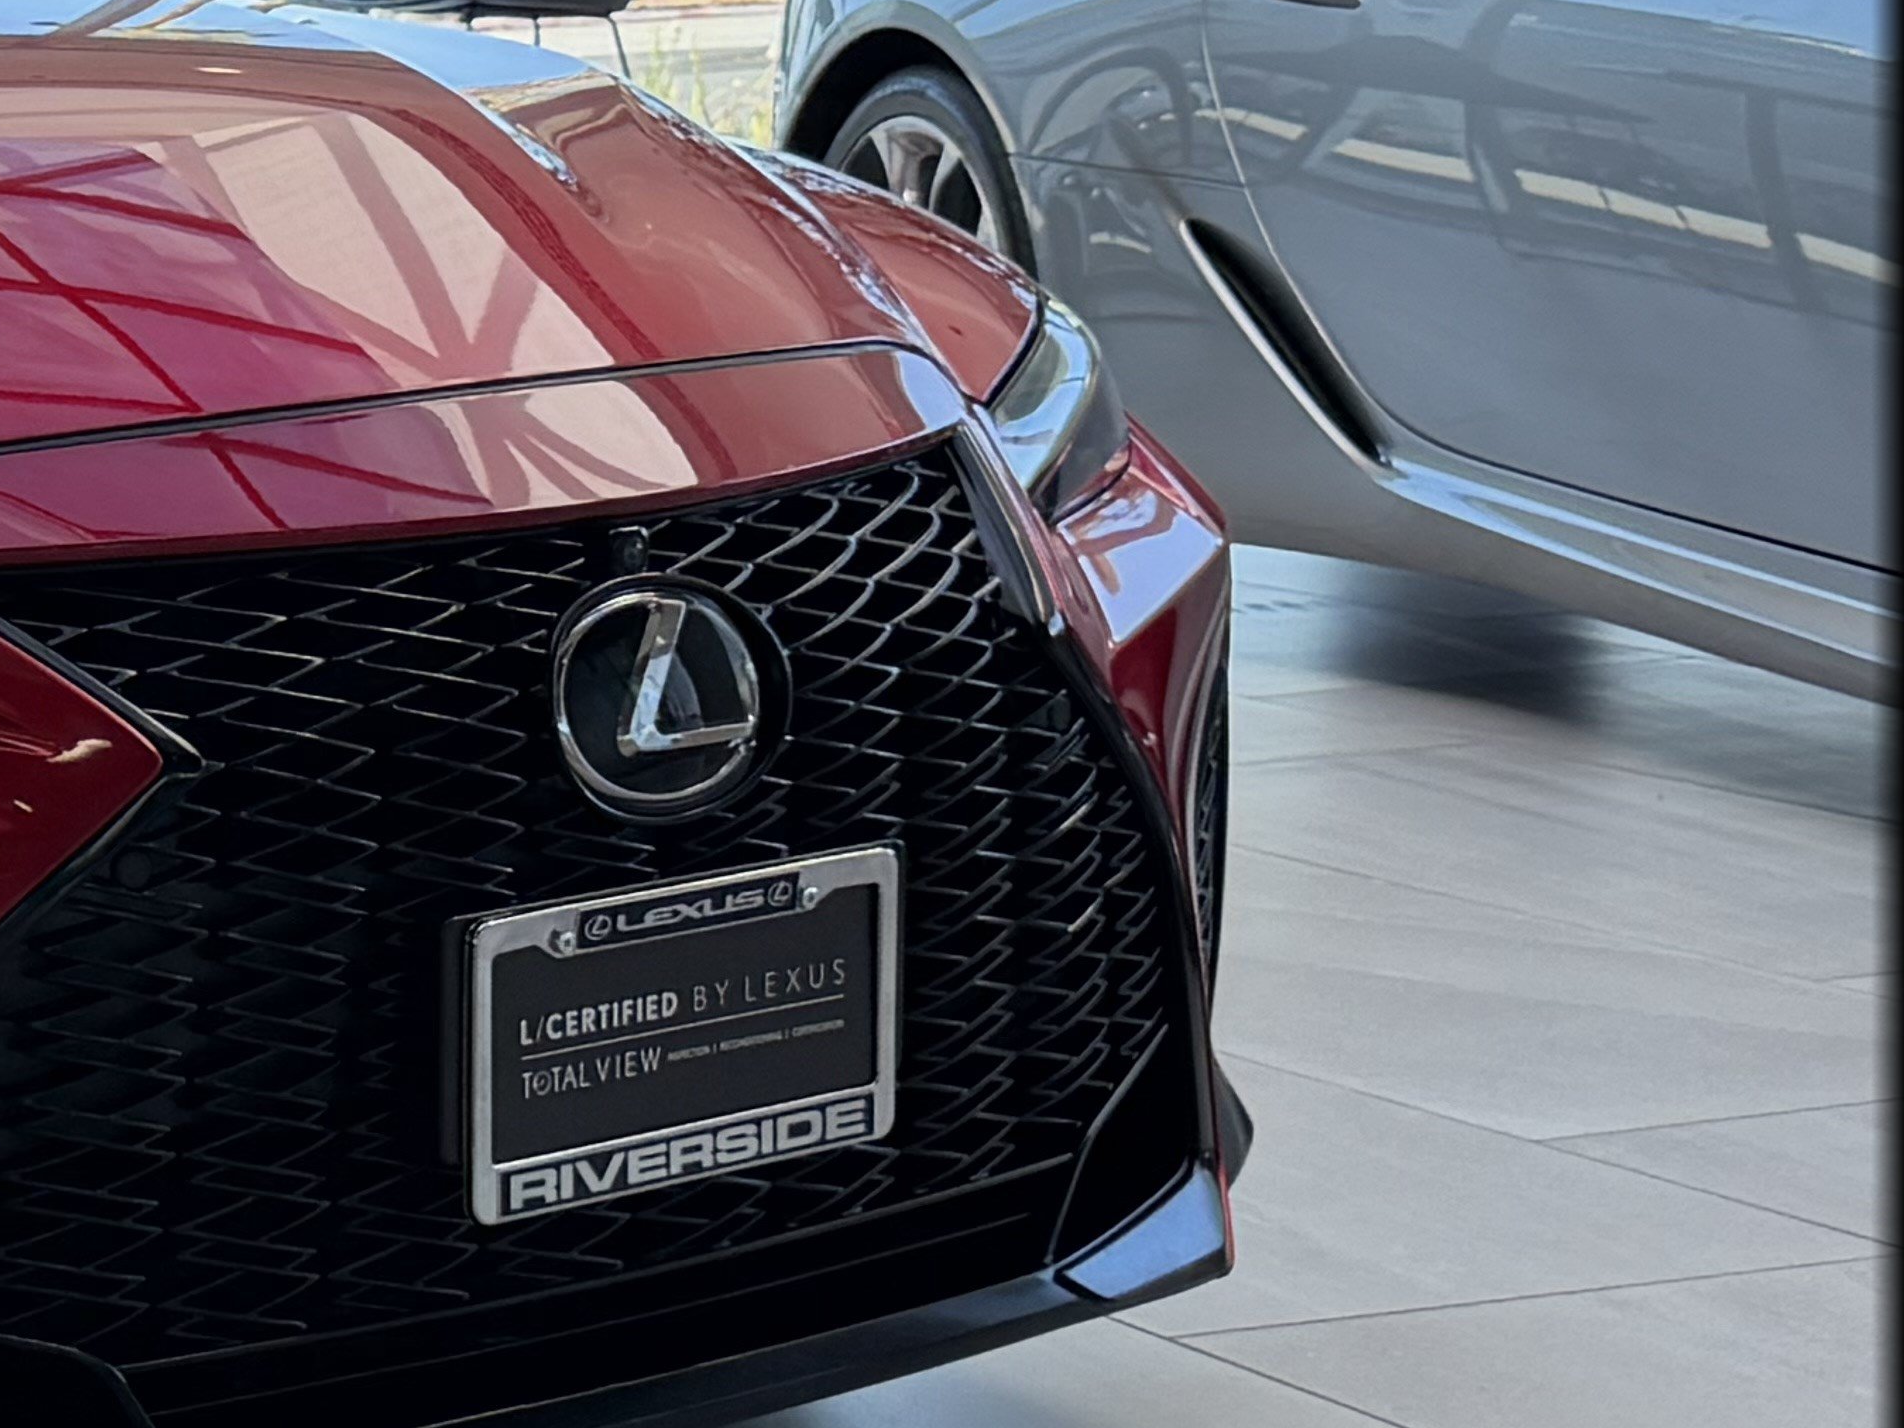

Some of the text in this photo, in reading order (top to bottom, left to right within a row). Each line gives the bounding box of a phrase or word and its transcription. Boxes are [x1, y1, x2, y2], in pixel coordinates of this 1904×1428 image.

[616, 888, 766, 933] LEXUS
[519, 991, 679, 1047] L/CERTIFIED
[692, 979, 731, 1013] BY
[743, 958, 846, 1003] LEXUS
[508, 1097, 868, 1211] RIVERSIDE
